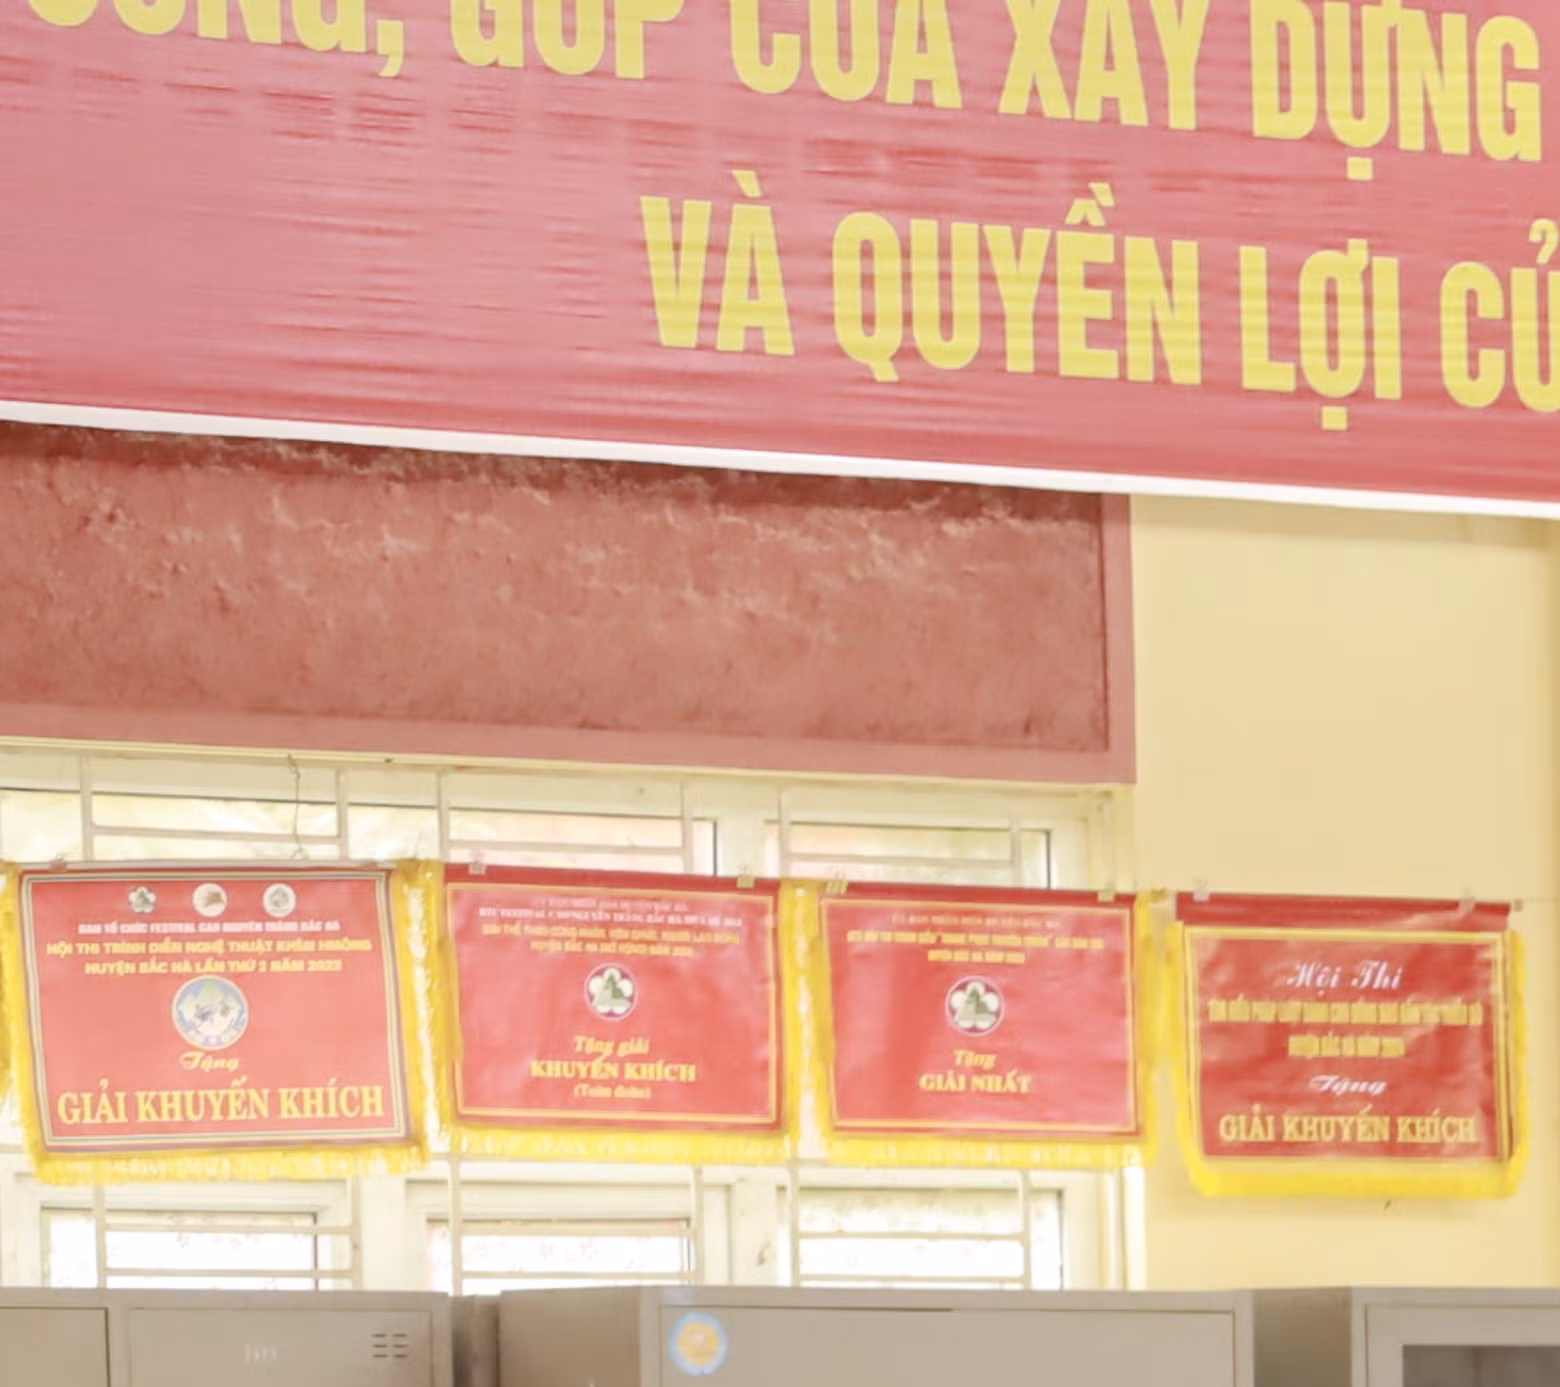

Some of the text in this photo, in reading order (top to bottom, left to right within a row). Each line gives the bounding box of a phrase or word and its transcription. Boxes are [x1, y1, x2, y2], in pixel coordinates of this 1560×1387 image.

[1249, 0, 1542, 181] DỰNG
[639, 169, 795, 357] VÀ
[832, 182, 1202, 385] QUYỀN
[1238, 238, 1402, 431] LỢI
[529, 1052, 698, 1083] KHUYẾN KHÍCH
[918, 1067, 1031, 1093] GIẢI NHẤT
[56, 1075, 385, 1126] GIẢI KHUYẾN KHÍCH
[1218, 1104, 1478, 1144] GIẢI KHUYẾN KHÍCH
